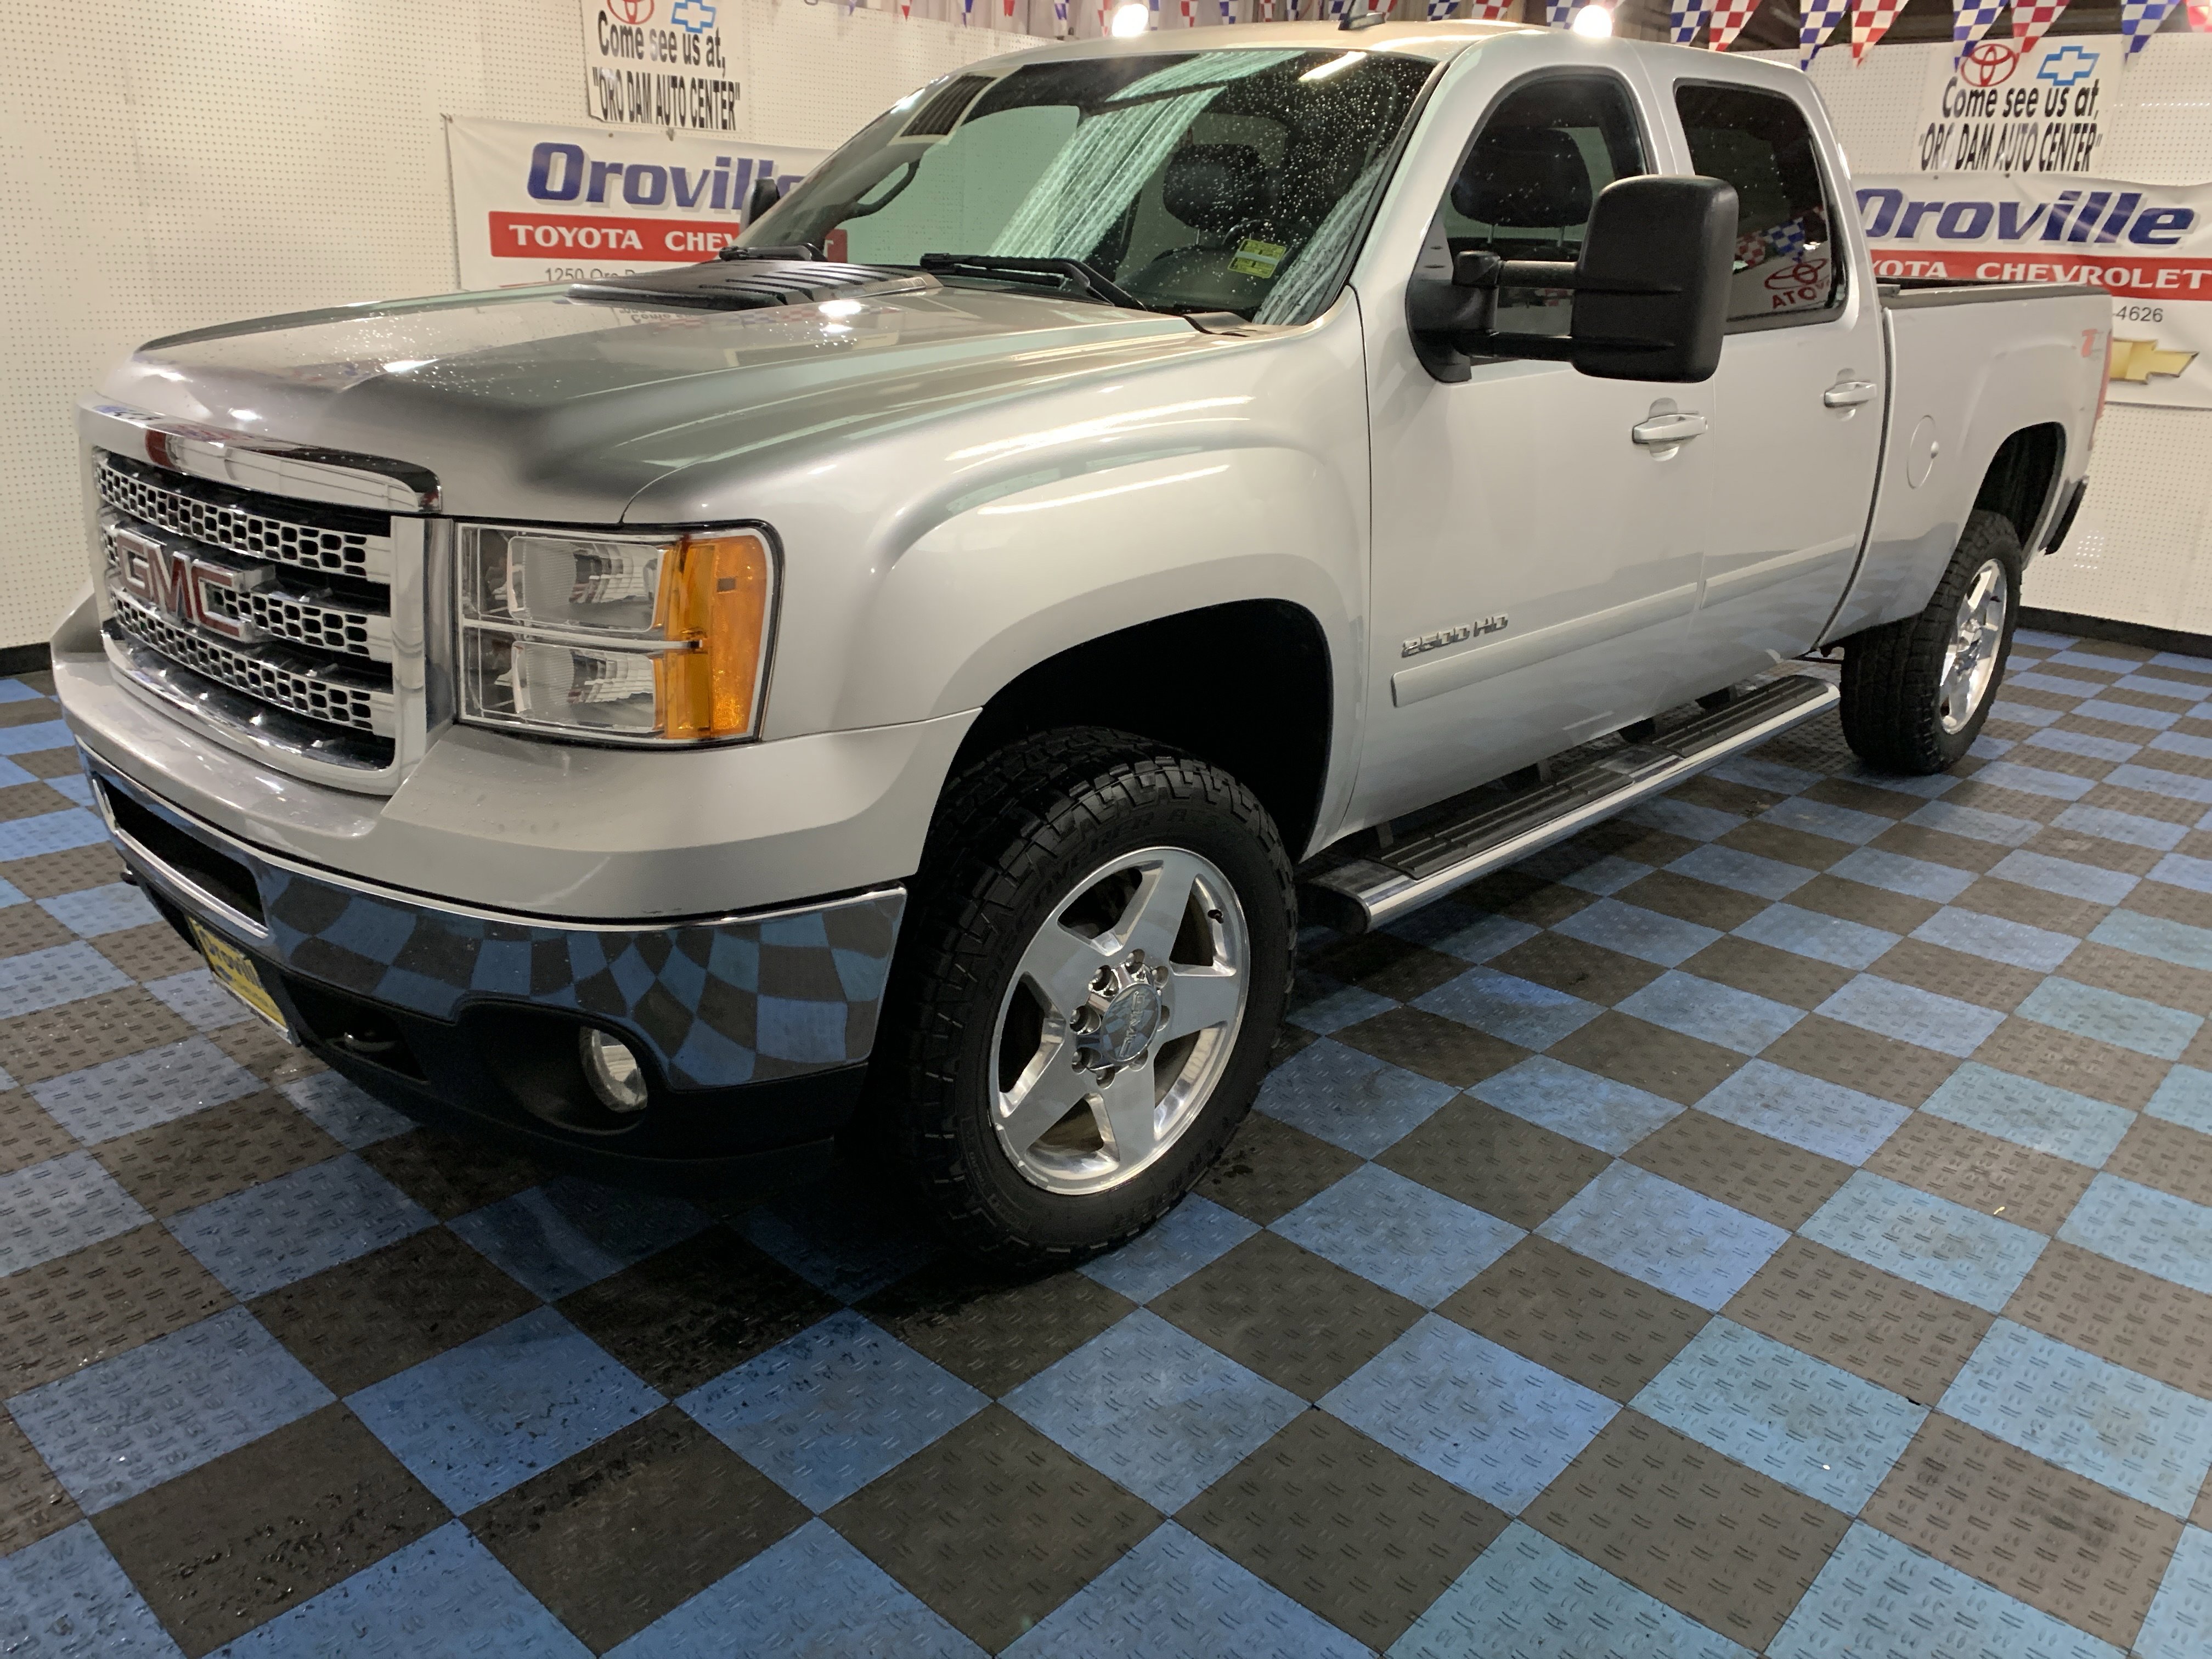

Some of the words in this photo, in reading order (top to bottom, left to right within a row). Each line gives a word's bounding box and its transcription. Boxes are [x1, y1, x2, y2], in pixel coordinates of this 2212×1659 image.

[597, 10, 645, 60] Come
[649, 29, 678, 64] see
[682, 32, 701, 66] us
[706, 27, 726, 79] at,
[626, 70, 653, 124] DAM
[656, 74, 686, 128] AUTO
[690, 77, 741, 131] CENTER"
[1942, 76, 1998, 118] Come
[2002, 87, 2039, 118] see
[2044, 87, 2070, 117] us
[2074, 78, 2100, 120] at,
[1954, 122, 1995, 171] DAM
[1993, 122, 2039, 172] AUTO
[2039, 122, 2103, 172] CENTER"
[508, 224, 643, 250] TOYOTA
[1855, 188, 2195, 245] Oroville
[1976, 262, 2212, 289] CHEVROLET
[116, 528, 245, 641] GMC
